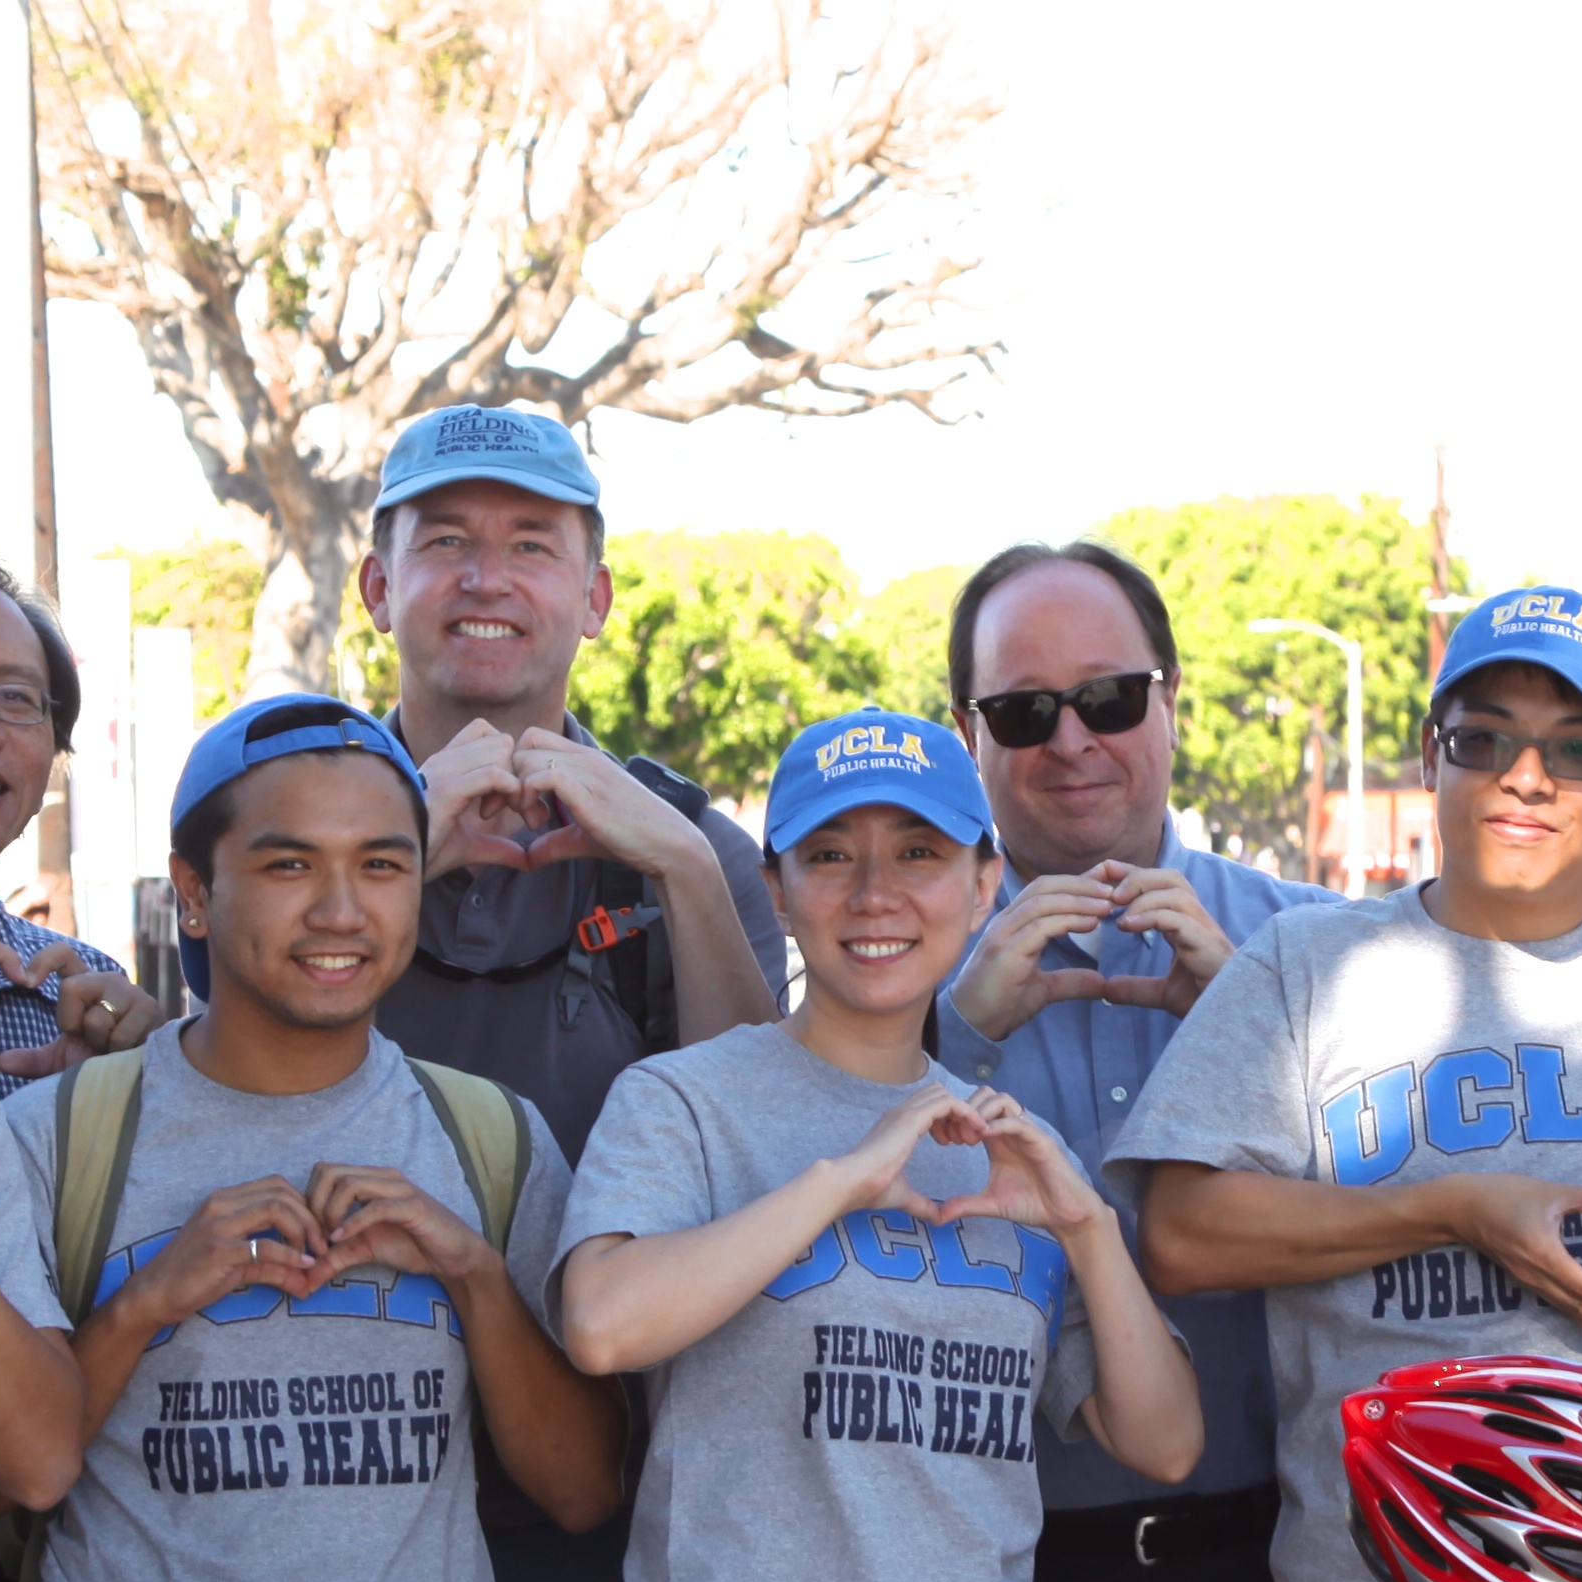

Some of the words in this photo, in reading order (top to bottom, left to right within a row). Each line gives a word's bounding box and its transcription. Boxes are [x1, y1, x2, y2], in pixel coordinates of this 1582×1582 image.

[438, 417, 538, 438] FIELDING
[442, 408, 483, 424] UCLA
[434, 444, 481, 457] PUBLIC
[484, 444, 540, 454] HEALTH
[436, 434, 488, 448] SCHOOL
[494, 434, 513, 443] OF
[1493, 622, 1538, 638] PUBLIC
[815, 726, 931, 771] UCLA
[823, 759, 868, 782] PUBLIC
[870, 758, 923, 775] HEALTH
[1372, 1250, 1522, 1320] PUBLIC
[813, 1325, 925, 1374] FIELDING
[930, 1339, 1032, 1389] SCHOOL
[158, 1379, 280, 1422] FIELDING
[288, 1373, 403, 1416] SCHOOL
[413, 1369, 445, 1410] OF
[803, 1371, 924, 1448] PUBLIC
[930, 1386, 1035, 1463] HEAL
[142, 1425, 289, 1495] PUBLIC
[299, 1413, 451, 1486] HEALTH
